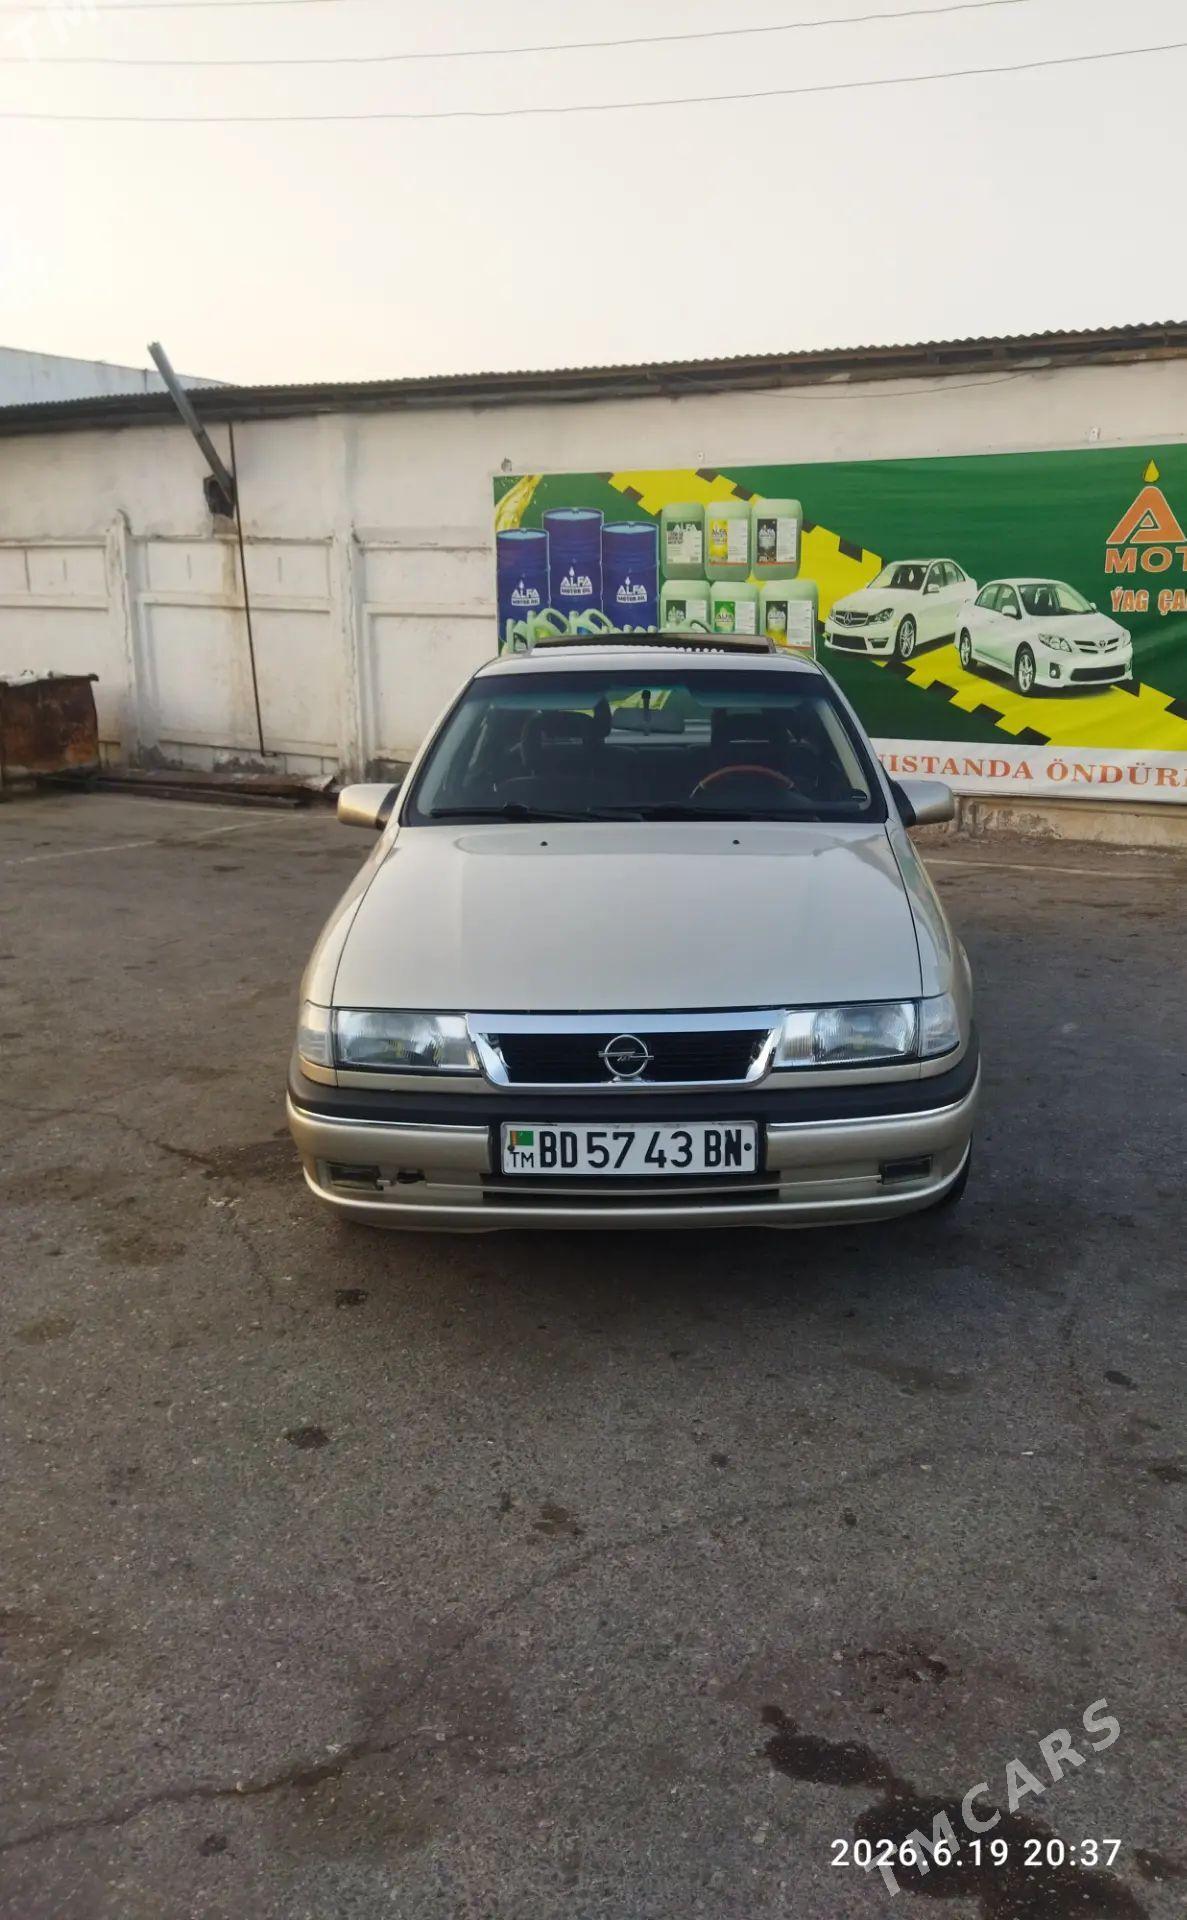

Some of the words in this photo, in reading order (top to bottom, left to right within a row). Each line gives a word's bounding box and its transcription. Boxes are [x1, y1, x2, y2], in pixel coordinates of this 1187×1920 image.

[559, 575, 592, 587] ALFA
[511, 588, 540, 598] ALFA
[617, 584, 647, 595] ALFA
[1110, 586, 1149, 612] ÝAG
[510, 1151, 534, 1168] TM
